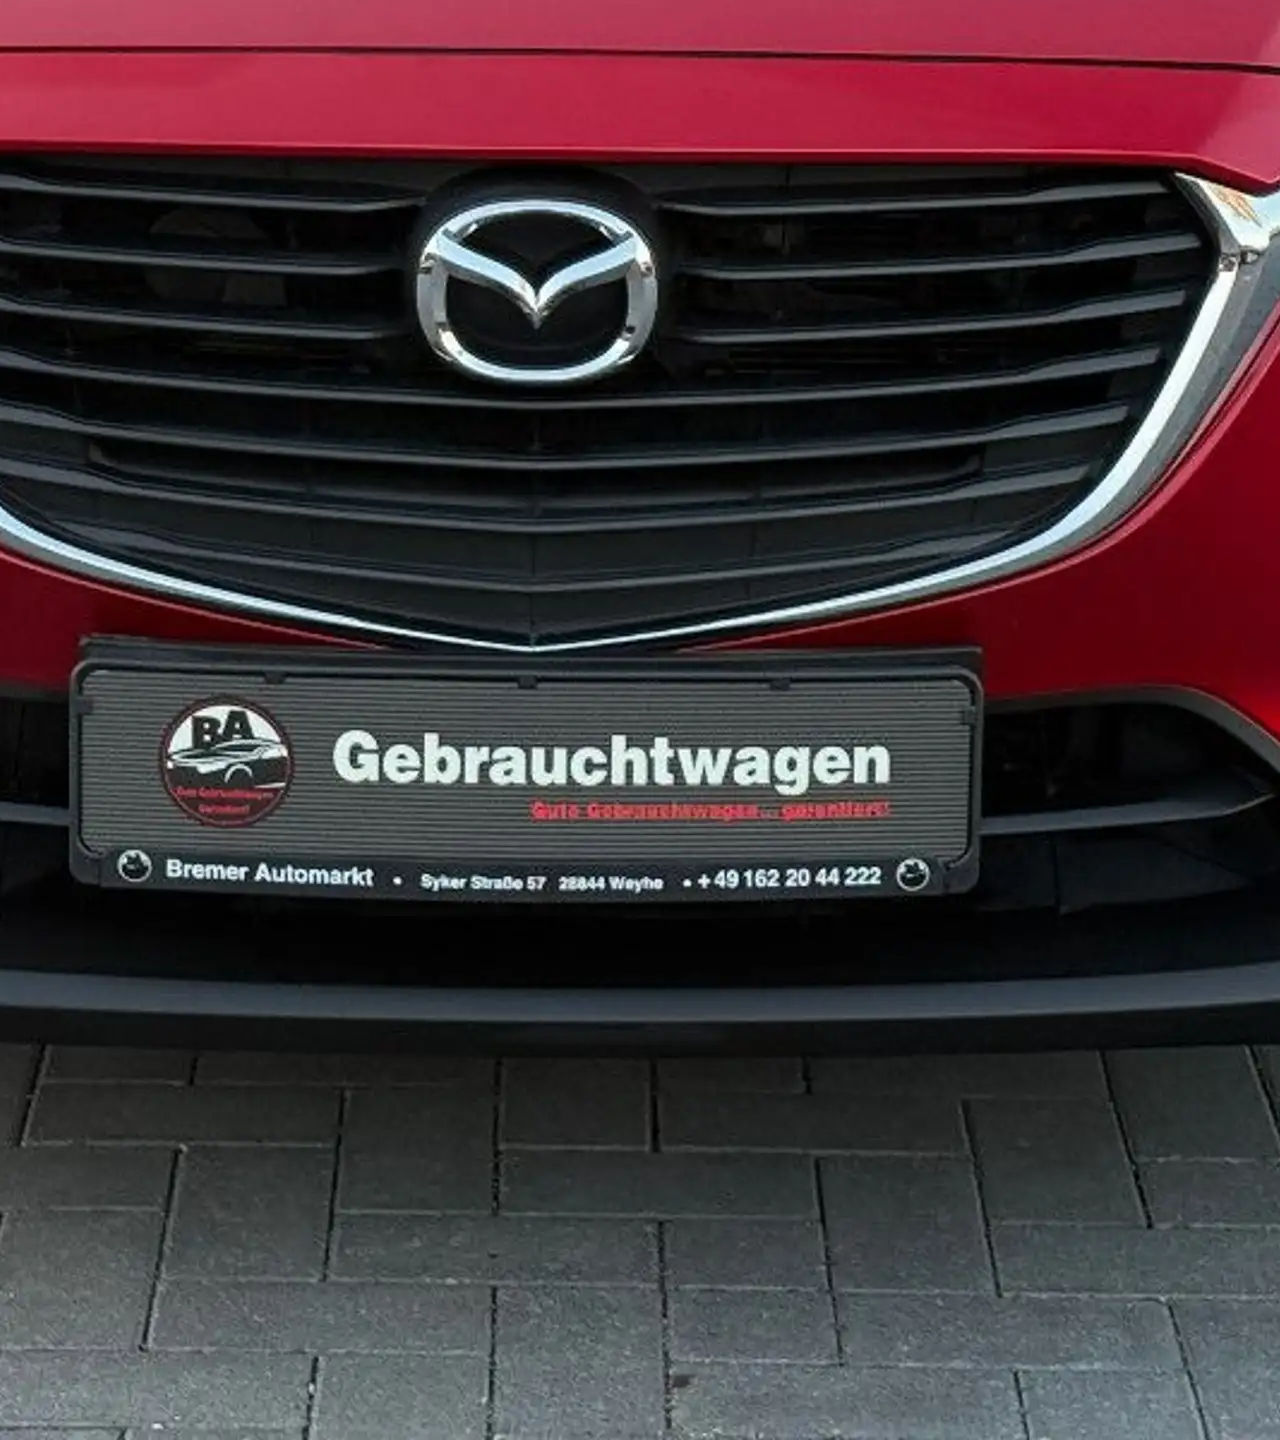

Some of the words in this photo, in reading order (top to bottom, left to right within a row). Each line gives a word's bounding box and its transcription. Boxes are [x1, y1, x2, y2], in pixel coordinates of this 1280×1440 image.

[192, 711, 255, 749] BA
[332, 729, 892, 795] Gebrauchtwagen
[166, 859, 249, 881] Bremer
[254, 862, 375, 886] Automarkt
[420, 873, 467, 891] Syker
[527, 875, 547, 890] 57
[743, 868, 780, 888] 162
[785, 868, 811, 887] 20
[815, 867, 840, 886] 44
[844, 866, 882, 886] 222
